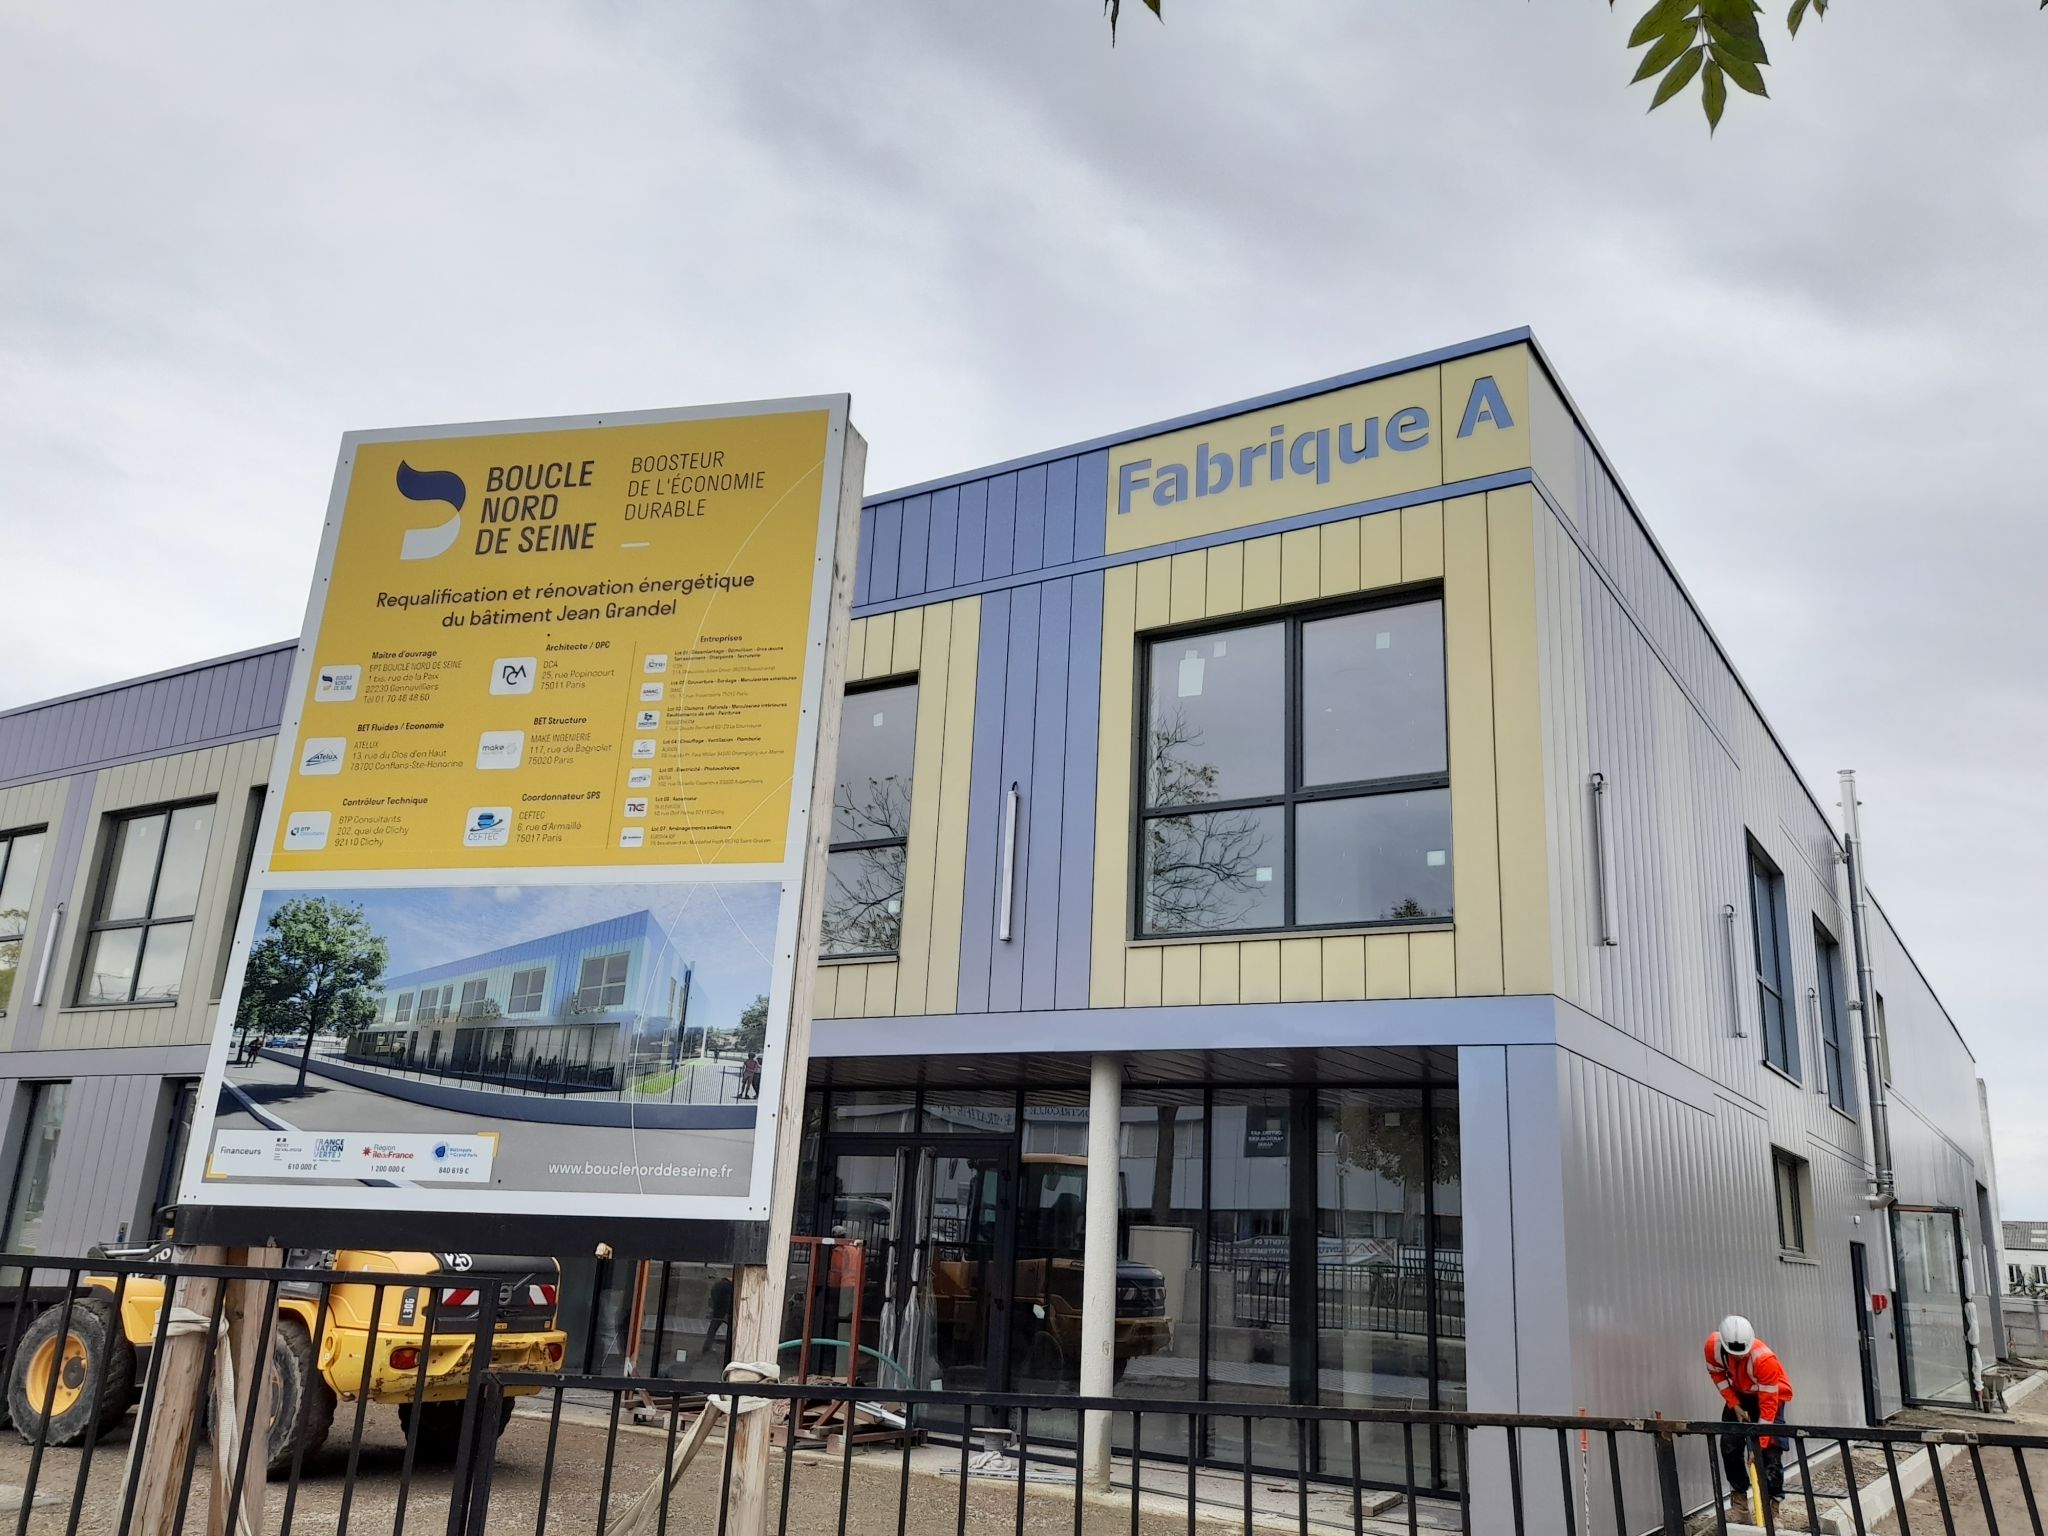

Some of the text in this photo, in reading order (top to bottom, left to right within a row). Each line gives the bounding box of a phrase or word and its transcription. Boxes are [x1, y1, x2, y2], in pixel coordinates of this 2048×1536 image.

[1118, 375, 1515, 515] Fabrique A
[631, 451, 725, 474] BOOSTEUR
[486, 460, 595, 492] BOUCLE
[627, 471, 766, 497] DE L'ÉCONOMIE
[480, 493, 559, 524] NORD
[624, 498, 707, 521] DURABLE
[475, 522, 597, 555] DE SEINE
[376, 572, 755, 611] Requalification et rénovation énergétique
[442, 599, 677, 628] du bâtiment Jean Grandel
[700, 634, 743, 643] Entreprises
[545, 643, 588, 651] Architecte
[595, 641, 610, 649] OPC
[398, 650, 437, 659] d'ouvrage
[382, 662, 409, 672] BOUCLE
[410, 661, 431, 671] NORD
[431, 661, 441, 670] DE
[442, 660, 462, 669] SEINE
[543, 660, 558, 669] DCA
[402, 673, 414, 681] de
[415, 673, 422, 681] la
[554, 671, 568, 679] rue
[570, 669, 614, 679] Popincourt
[541, 681, 586, 690] 75011 Paris
[533, 717, 587, 726] BET Structure
[357, 723, 370, 732] BET
[371, 723, 399, 732] Fluides
[531, 734, 551, 743] MAKE
[364, 752, 378, 760] rue
[379, 751, 390, 759] du
[391, 750, 408, 759] Clos
[428, 749, 447, 758] Haut
[547, 745, 561, 754] rue
[563, 745, 574, 753] de
[575, 744, 612, 755] Bagnolet
[350, 760, 464, 771] 78700 Conflans-Ste-Honorine
[528, 756, 574, 765] 75020 Paris
[521, 791, 601, 802] Coordonnateur SPS
[342, 797, 429, 807] Contrôleur Technique
[339, 815, 401, 824] BTP Consultants
[519, 811, 546, 820] CEFTEC
[373, 826, 384, 834] de
[385, 825, 410, 836] Clichy
[525, 823, 540, 831] rue
[467, 832, 499, 841] CEFTEC
[516, 833, 562, 843] 75017 Paris
[360, 837, 384, 847] Clichy
[220, 1146, 261, 1156] Financeurs
[374, 1144, 396, 1152] Région
[375, 1165, 387, 1173] 200
[548, 1161, 733, 1178] www.bouclenorddeseine.fr
[402, 1297, 415, 1319] L30G
